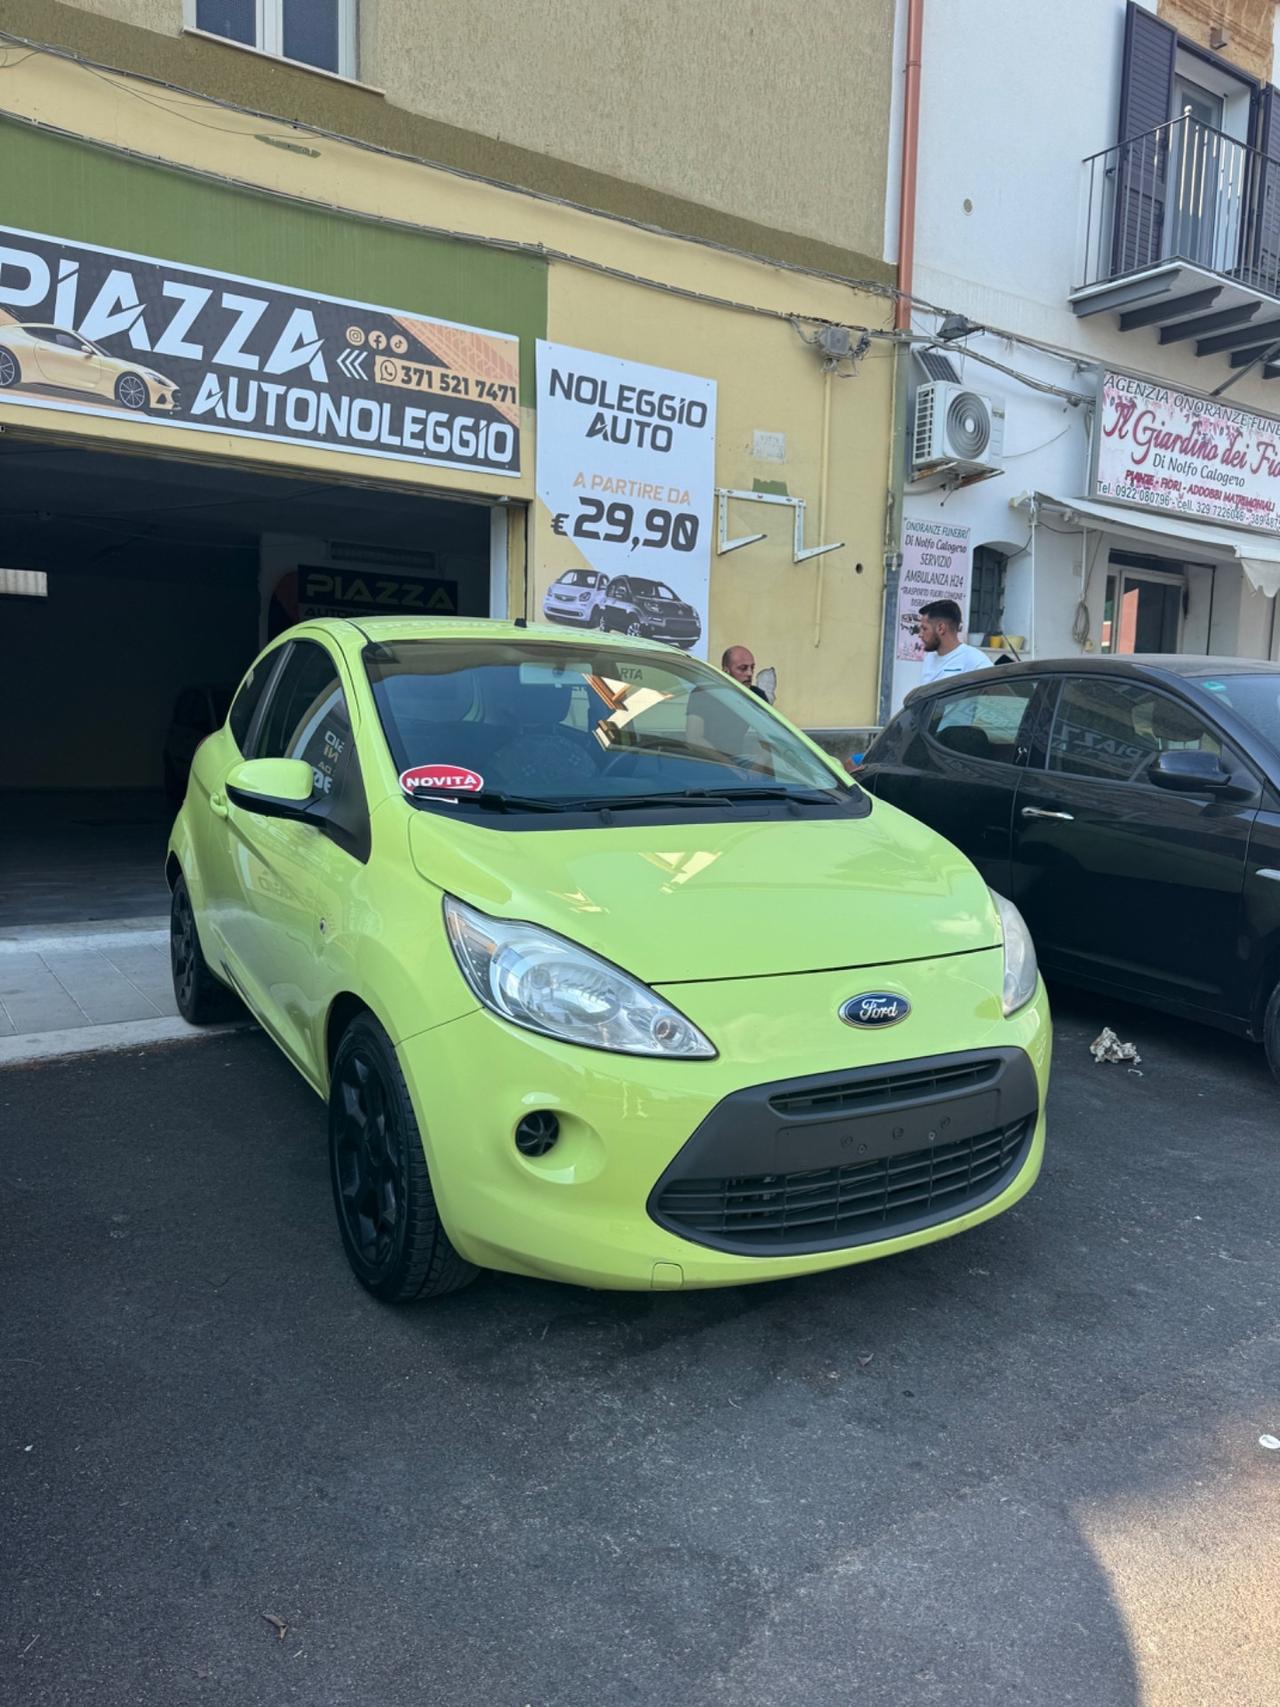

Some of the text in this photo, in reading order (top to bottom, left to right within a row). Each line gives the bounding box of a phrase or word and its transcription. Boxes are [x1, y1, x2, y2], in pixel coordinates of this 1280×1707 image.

[401, 365, 517, 404] 371 521 7471
[549, 368, 708, 428] NOLEGGIO
[1104, 375, 1170, 404] AGENZIA
[1174, 394, 1251, 427] ONORANZE
[190, 372, 514, 463] AUTONOLEGGIO
[585, 412, 673, 453] AUTO
[1131, 410, 1219, 465] Giardino
[1221, 430, 1250, 469] dei
[573, 471, 691, 506] A PARTIRE DA
[1153, 453, 1246, 488] Di Nolfo Calogero
[1115, 484, 1138, 500] 0922
[919, 553, 952, 569] SERVIZIO
[936, 539, 968, 555] Calogero
[305, 573, 456, 610] PIAZZA
[904, 569, 964, 588] AMBULANZA H24
[860, 998, 898, 1020] Ford
